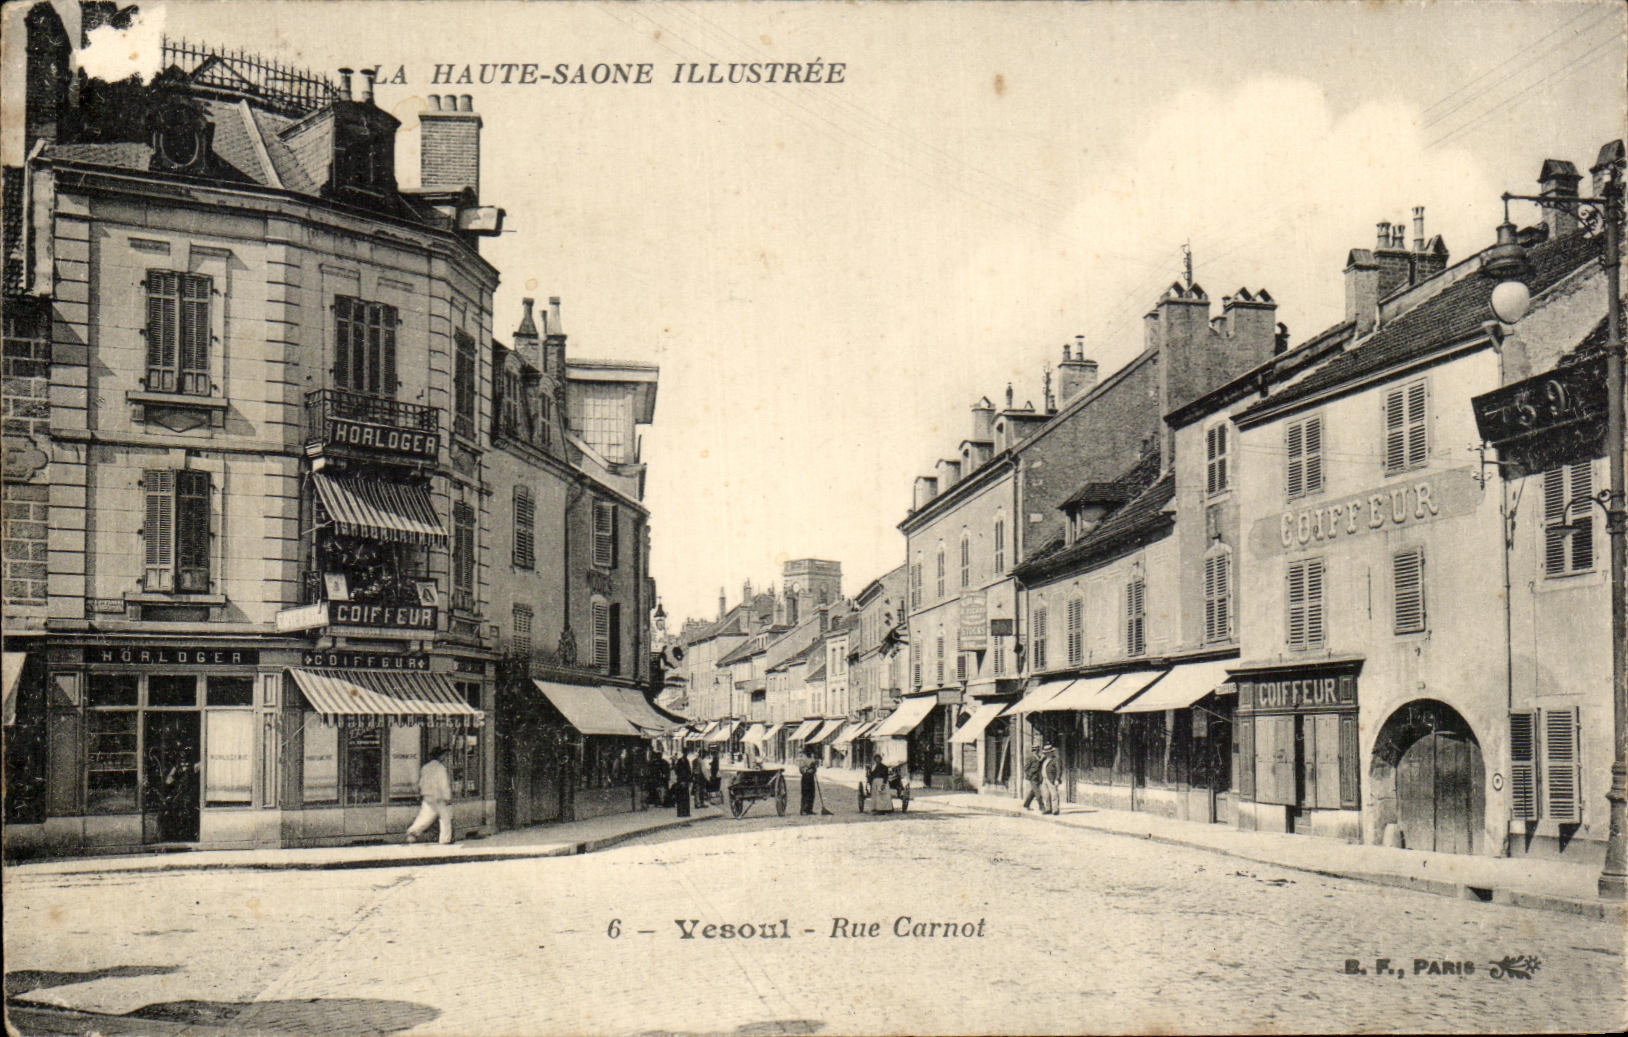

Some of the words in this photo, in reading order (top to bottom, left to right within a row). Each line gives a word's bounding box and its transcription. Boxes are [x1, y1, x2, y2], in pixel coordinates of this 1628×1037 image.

[335, 424, 436, 454] HORLOGER
[1280, 481, 1440, 547] COIFFEUR
[337, 604, 432, 627] COIFFEUR
[102, 651, 241, 664] HORLOGER
[314, 654, 415, 668] COIFFEUR
[1259, 678, 1337, 706] COIFFEUR
